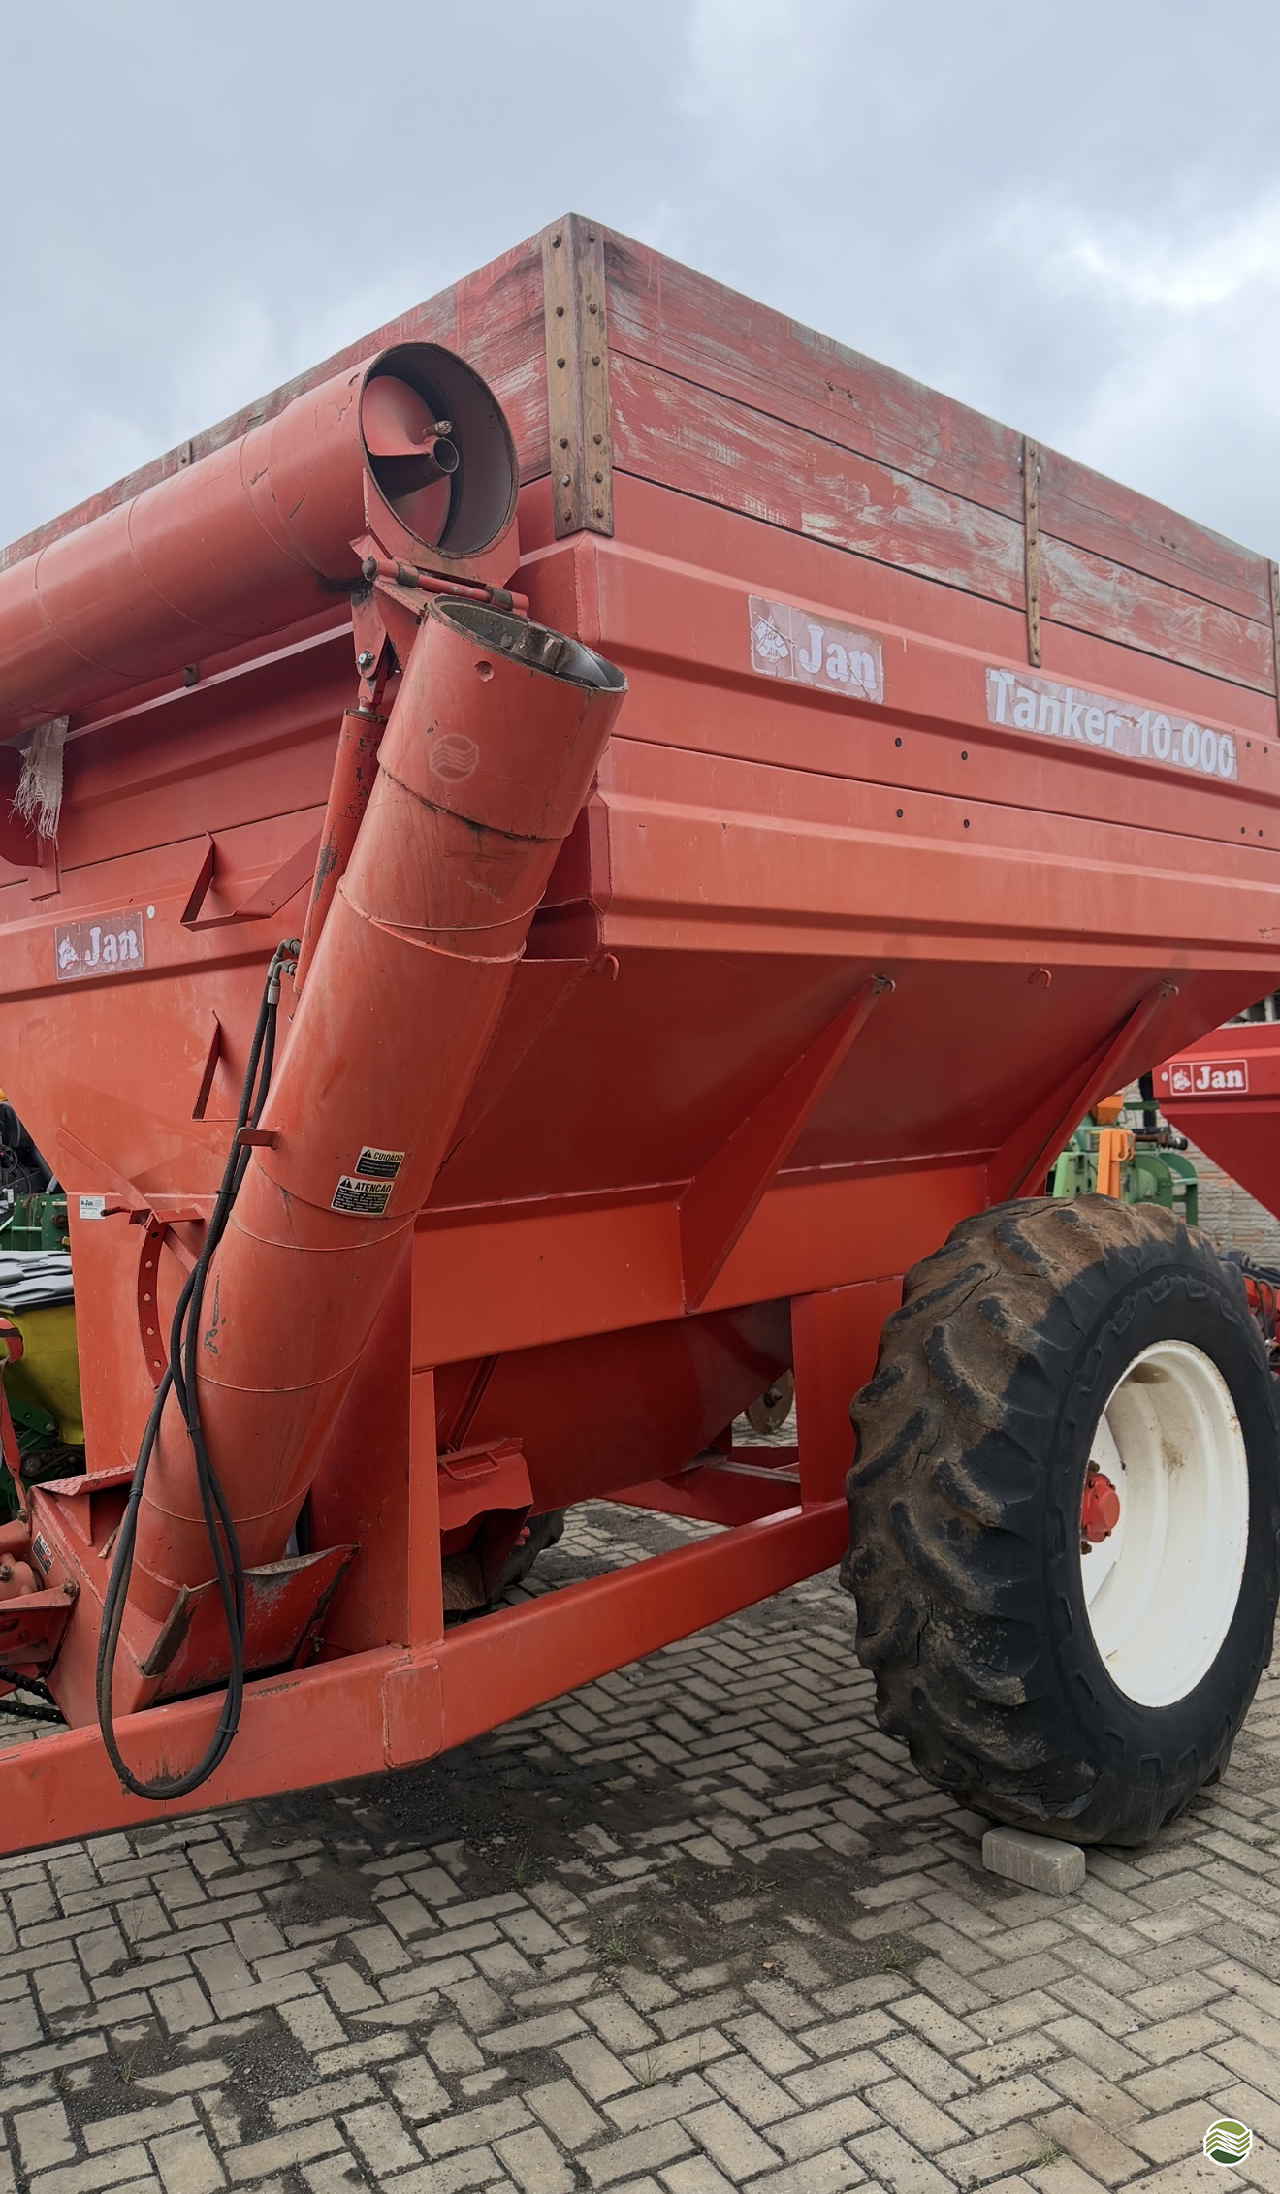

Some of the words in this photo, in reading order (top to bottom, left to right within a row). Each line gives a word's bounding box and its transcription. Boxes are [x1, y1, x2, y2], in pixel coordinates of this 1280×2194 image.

[798, 623, 877, 690] Jan
[989, 669, 1123, 749] Tanker
[1137, 710, 1234, 778] 10.000
[84, 926, 140, 967] Jan
[1195, 1065, 1245, 1090] Jan
